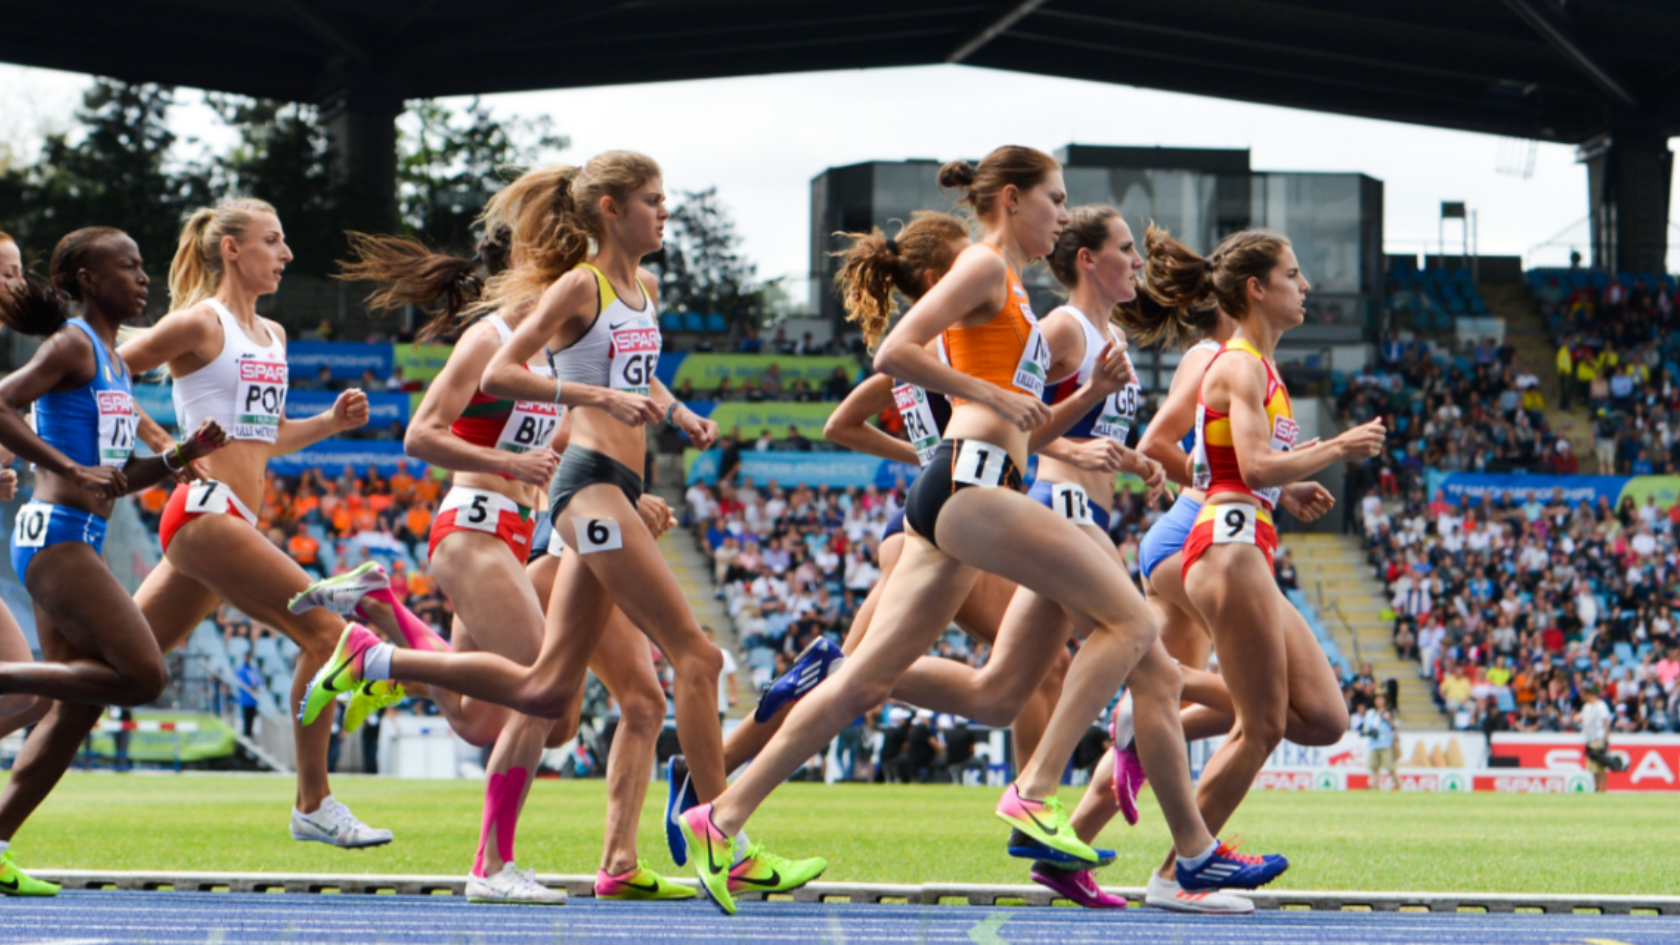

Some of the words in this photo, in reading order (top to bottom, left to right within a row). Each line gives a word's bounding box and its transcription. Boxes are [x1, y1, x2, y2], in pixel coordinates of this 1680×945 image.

[617, 332, 657, 350] SPAR
[241, 362, 284, 382] SPAR
[623, 354, 658, 386] GE
[1114, 386, 1137, 417] GB
[971, 450, 989, 479] 1
[198, 482, 218, 507] 7
[468, 494, 489, 523] 5
[18, 510, 44, 539] 10
[586, 518, 610, 546] 6
[1224, 508, 1246, 537] 9
[1256, 772, 1312, 790] PAR
[1494, 776, 1564, 792] SPAR
